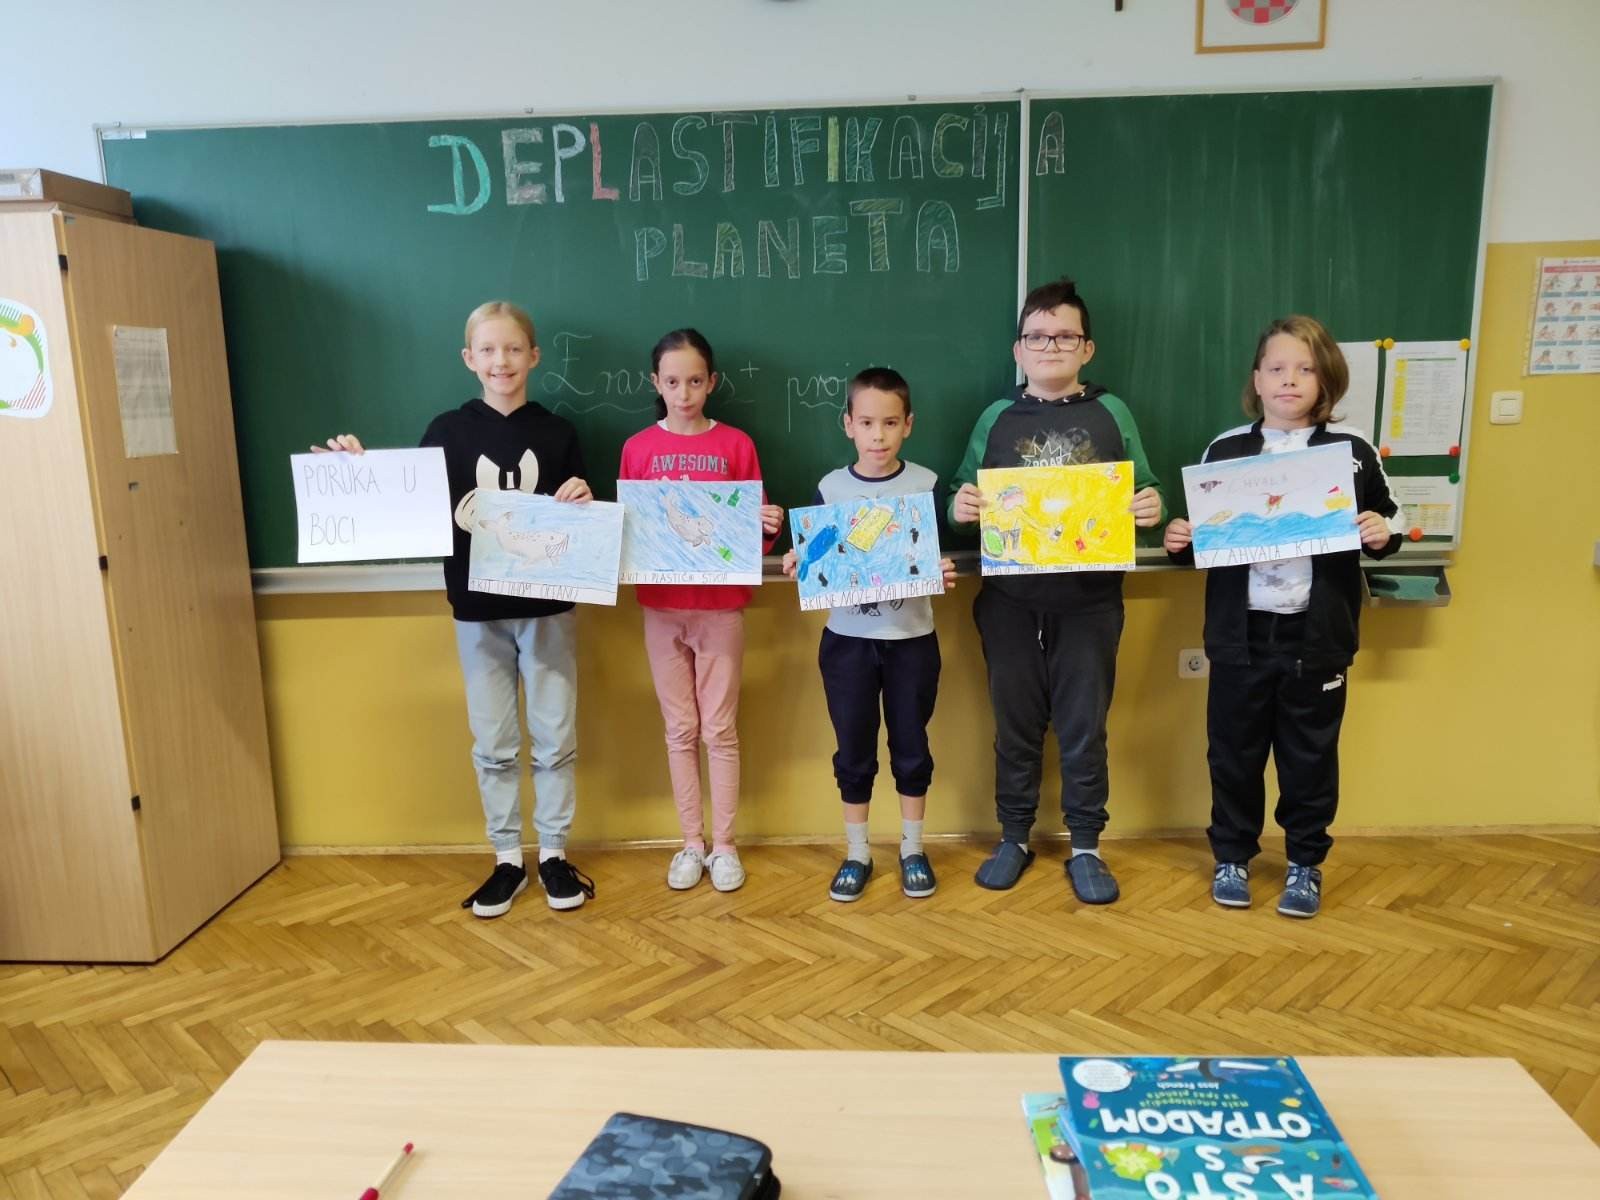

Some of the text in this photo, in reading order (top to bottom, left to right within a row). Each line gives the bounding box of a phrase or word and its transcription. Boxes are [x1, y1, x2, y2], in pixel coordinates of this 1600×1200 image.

[632, 199, 962, 282] PLANETA
[303, 463, 417, 498] PORUKA U
[651, 453, 729, 476] AWESOME
[310, 512, 357, 547] BOCI
[1100, 1108, 1312, 1139] OTPADOM
[1195, 1144, 1225, 1172] S
